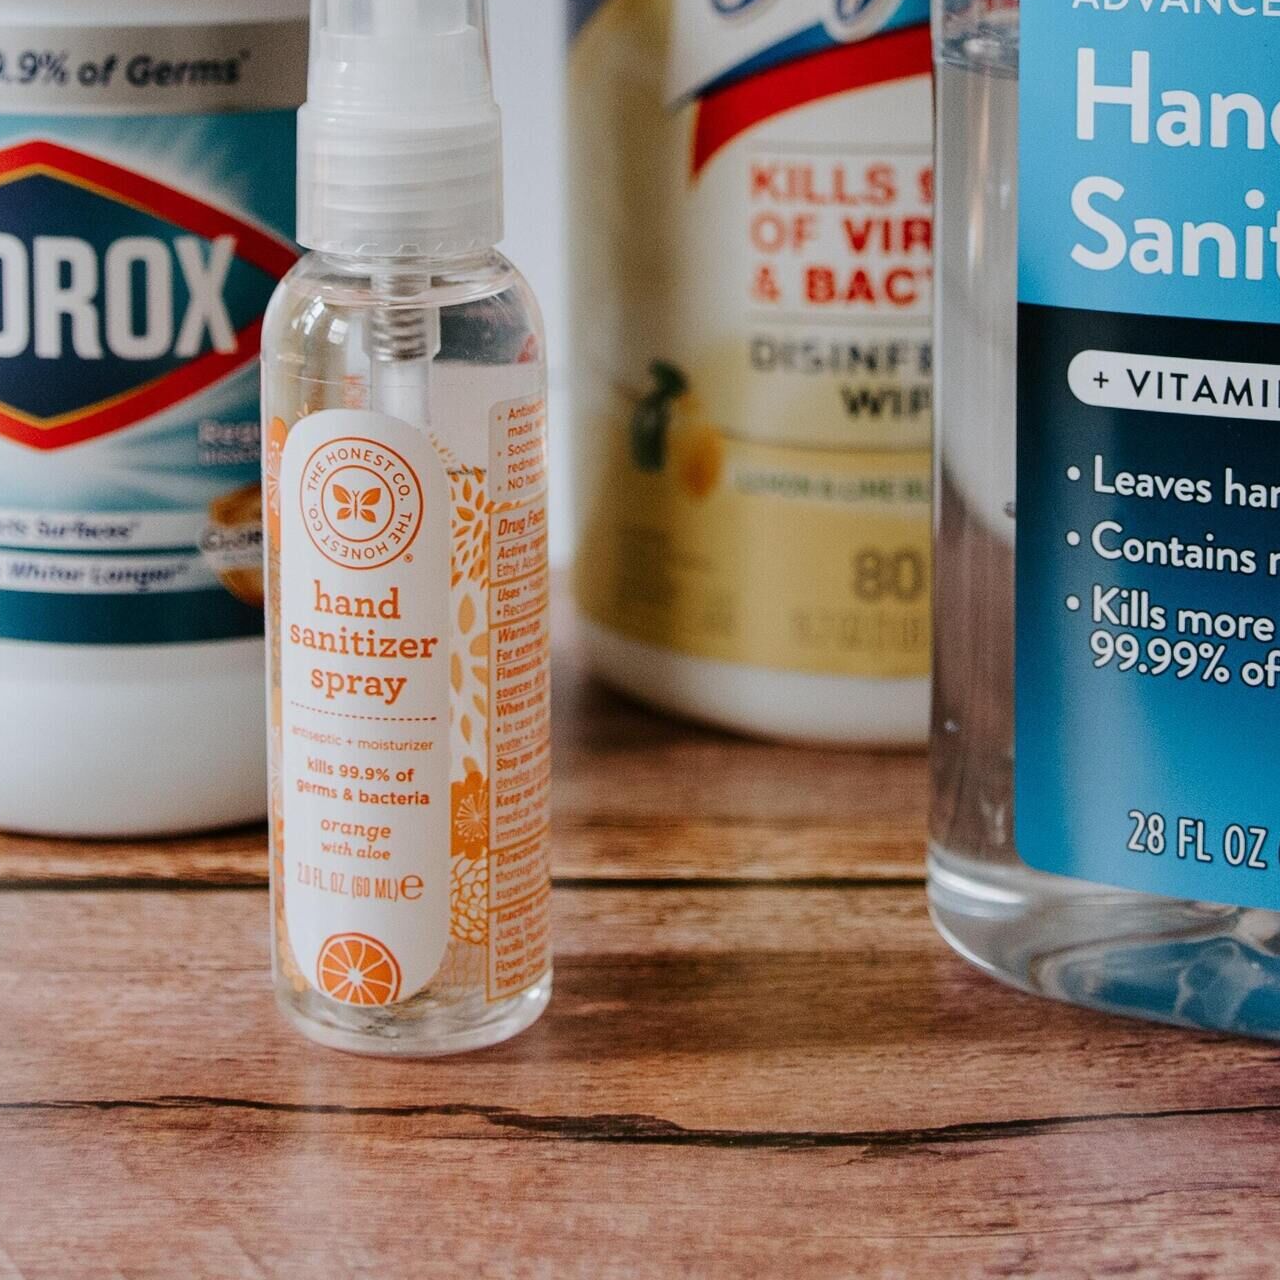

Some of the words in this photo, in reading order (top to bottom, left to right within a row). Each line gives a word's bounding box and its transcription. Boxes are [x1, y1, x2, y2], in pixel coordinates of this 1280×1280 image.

[77, 54, 117, 86] of
[750, 162, 897, 206] KILLS
[750, 211, 816, 254] OF
[752, 264, 780, 302] &
[804, 266, 933, 306] BAC
[308, 461, 326, 492] THE
[325, 448, 396, 472] HONEST
[392, 472, 411, 502] CO.
[1093, 454, 1213, 505] Leaves
[388, 512, 413, 545] THE
[498, 516, 526, 537] Drug
[320, 535, 389, 561] HONEST
[1091, 521, 1256, 575] Contains
[852, 547, 926, 602] 80
[314, 579, 401, 619] hand
[1092, 584, 1166, 631] Kills
[1177, 606, 1276, 644] more
[290, 623, 438, 659] sanitizer
[1090, 630, 1230, 684] 99.99%
[311, 668, 408, 705] spray
[291, 724, 343, 747] antiseptic
[357, 737, 433, 752] moisturizer
[306, 755, 334, 776] kills
[338, 764, 390, 782] 99.9%
[396, 768, 415, 782] of
[296, 778, 338, 799] germs
[342, 787, 354, 802] &
[358, 789, 430, 806] bacteria
[320, 818, 392, 842] orange
[1127, 810, 1166, 856] 28
[1177, 819, 1213, 864] FL
[1224, 823, 1268, 870] OZ
[321, 841, 353, 857] with
[356, 844, 391, 861] aloe
